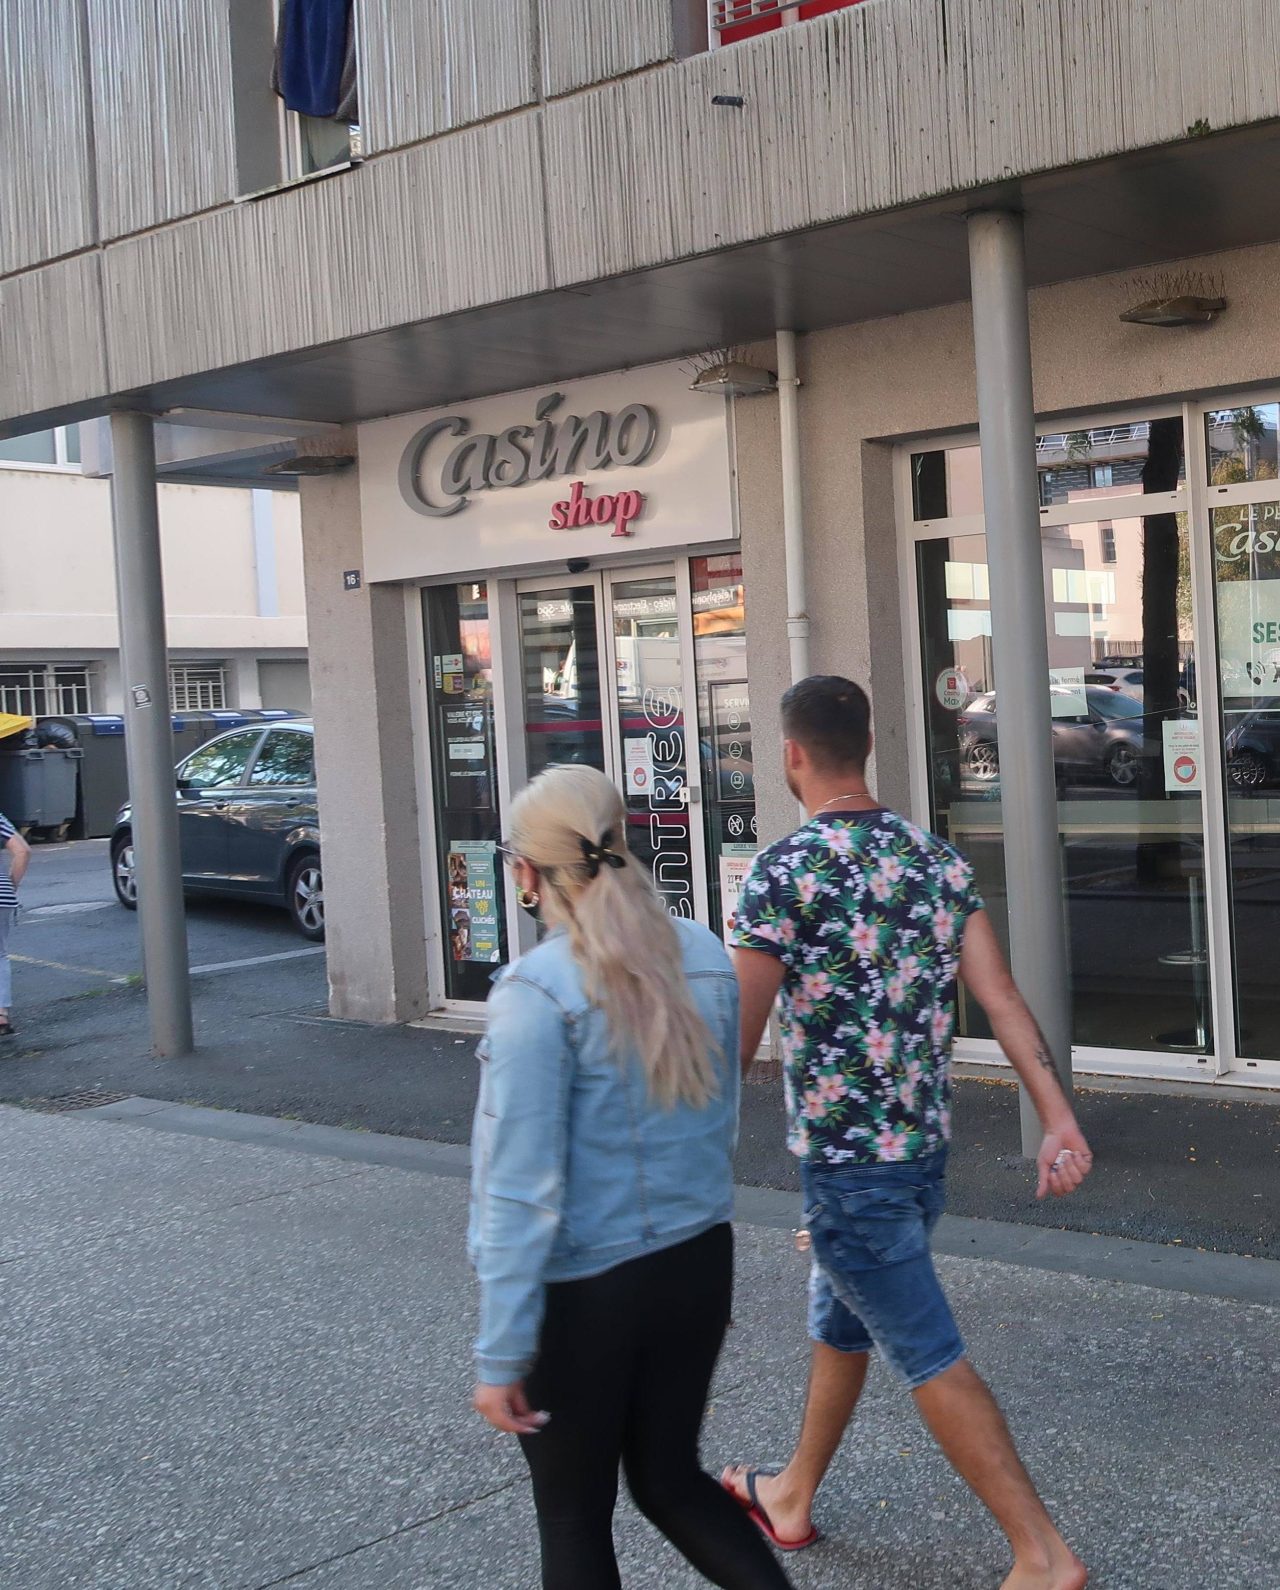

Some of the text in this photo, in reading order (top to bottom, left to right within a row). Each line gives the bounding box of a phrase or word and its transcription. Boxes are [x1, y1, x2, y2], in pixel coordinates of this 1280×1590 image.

[398, 391, 659, 517] Casino
[548, 481, 644, 537] shop
[1240, 506, 1259, 521] LE
